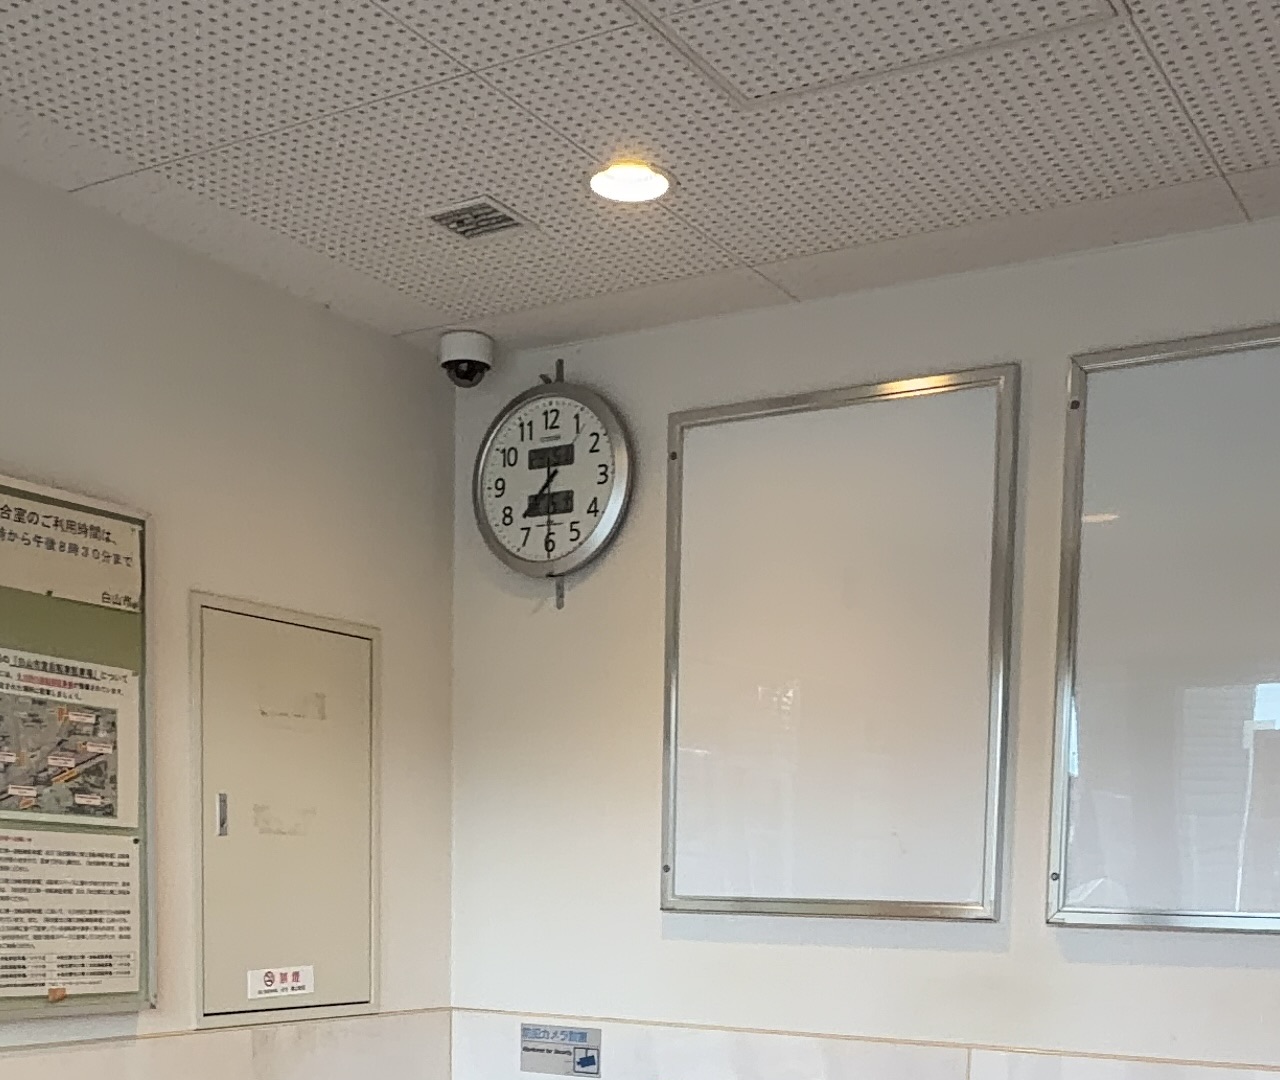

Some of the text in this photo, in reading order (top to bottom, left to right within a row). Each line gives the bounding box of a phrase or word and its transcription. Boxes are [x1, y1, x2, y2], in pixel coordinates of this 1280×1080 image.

[543, 409, 560, 430] 12
[574, 414, 580, 434] 1
[520, 421, 533, 442] 11
[589, 433, 600, 453] 2
[500, 447, 518, 468] 10
[597, 464, 608, 485] 3
[494, 478, 505, 498] 9
[502, 506, 513, 526] 8
[587, 497, 599, 517] 4
[520, 527, 531, 547] 7
[570, 521, 581, 542] 5
[544, 532, 556, 552] 6
